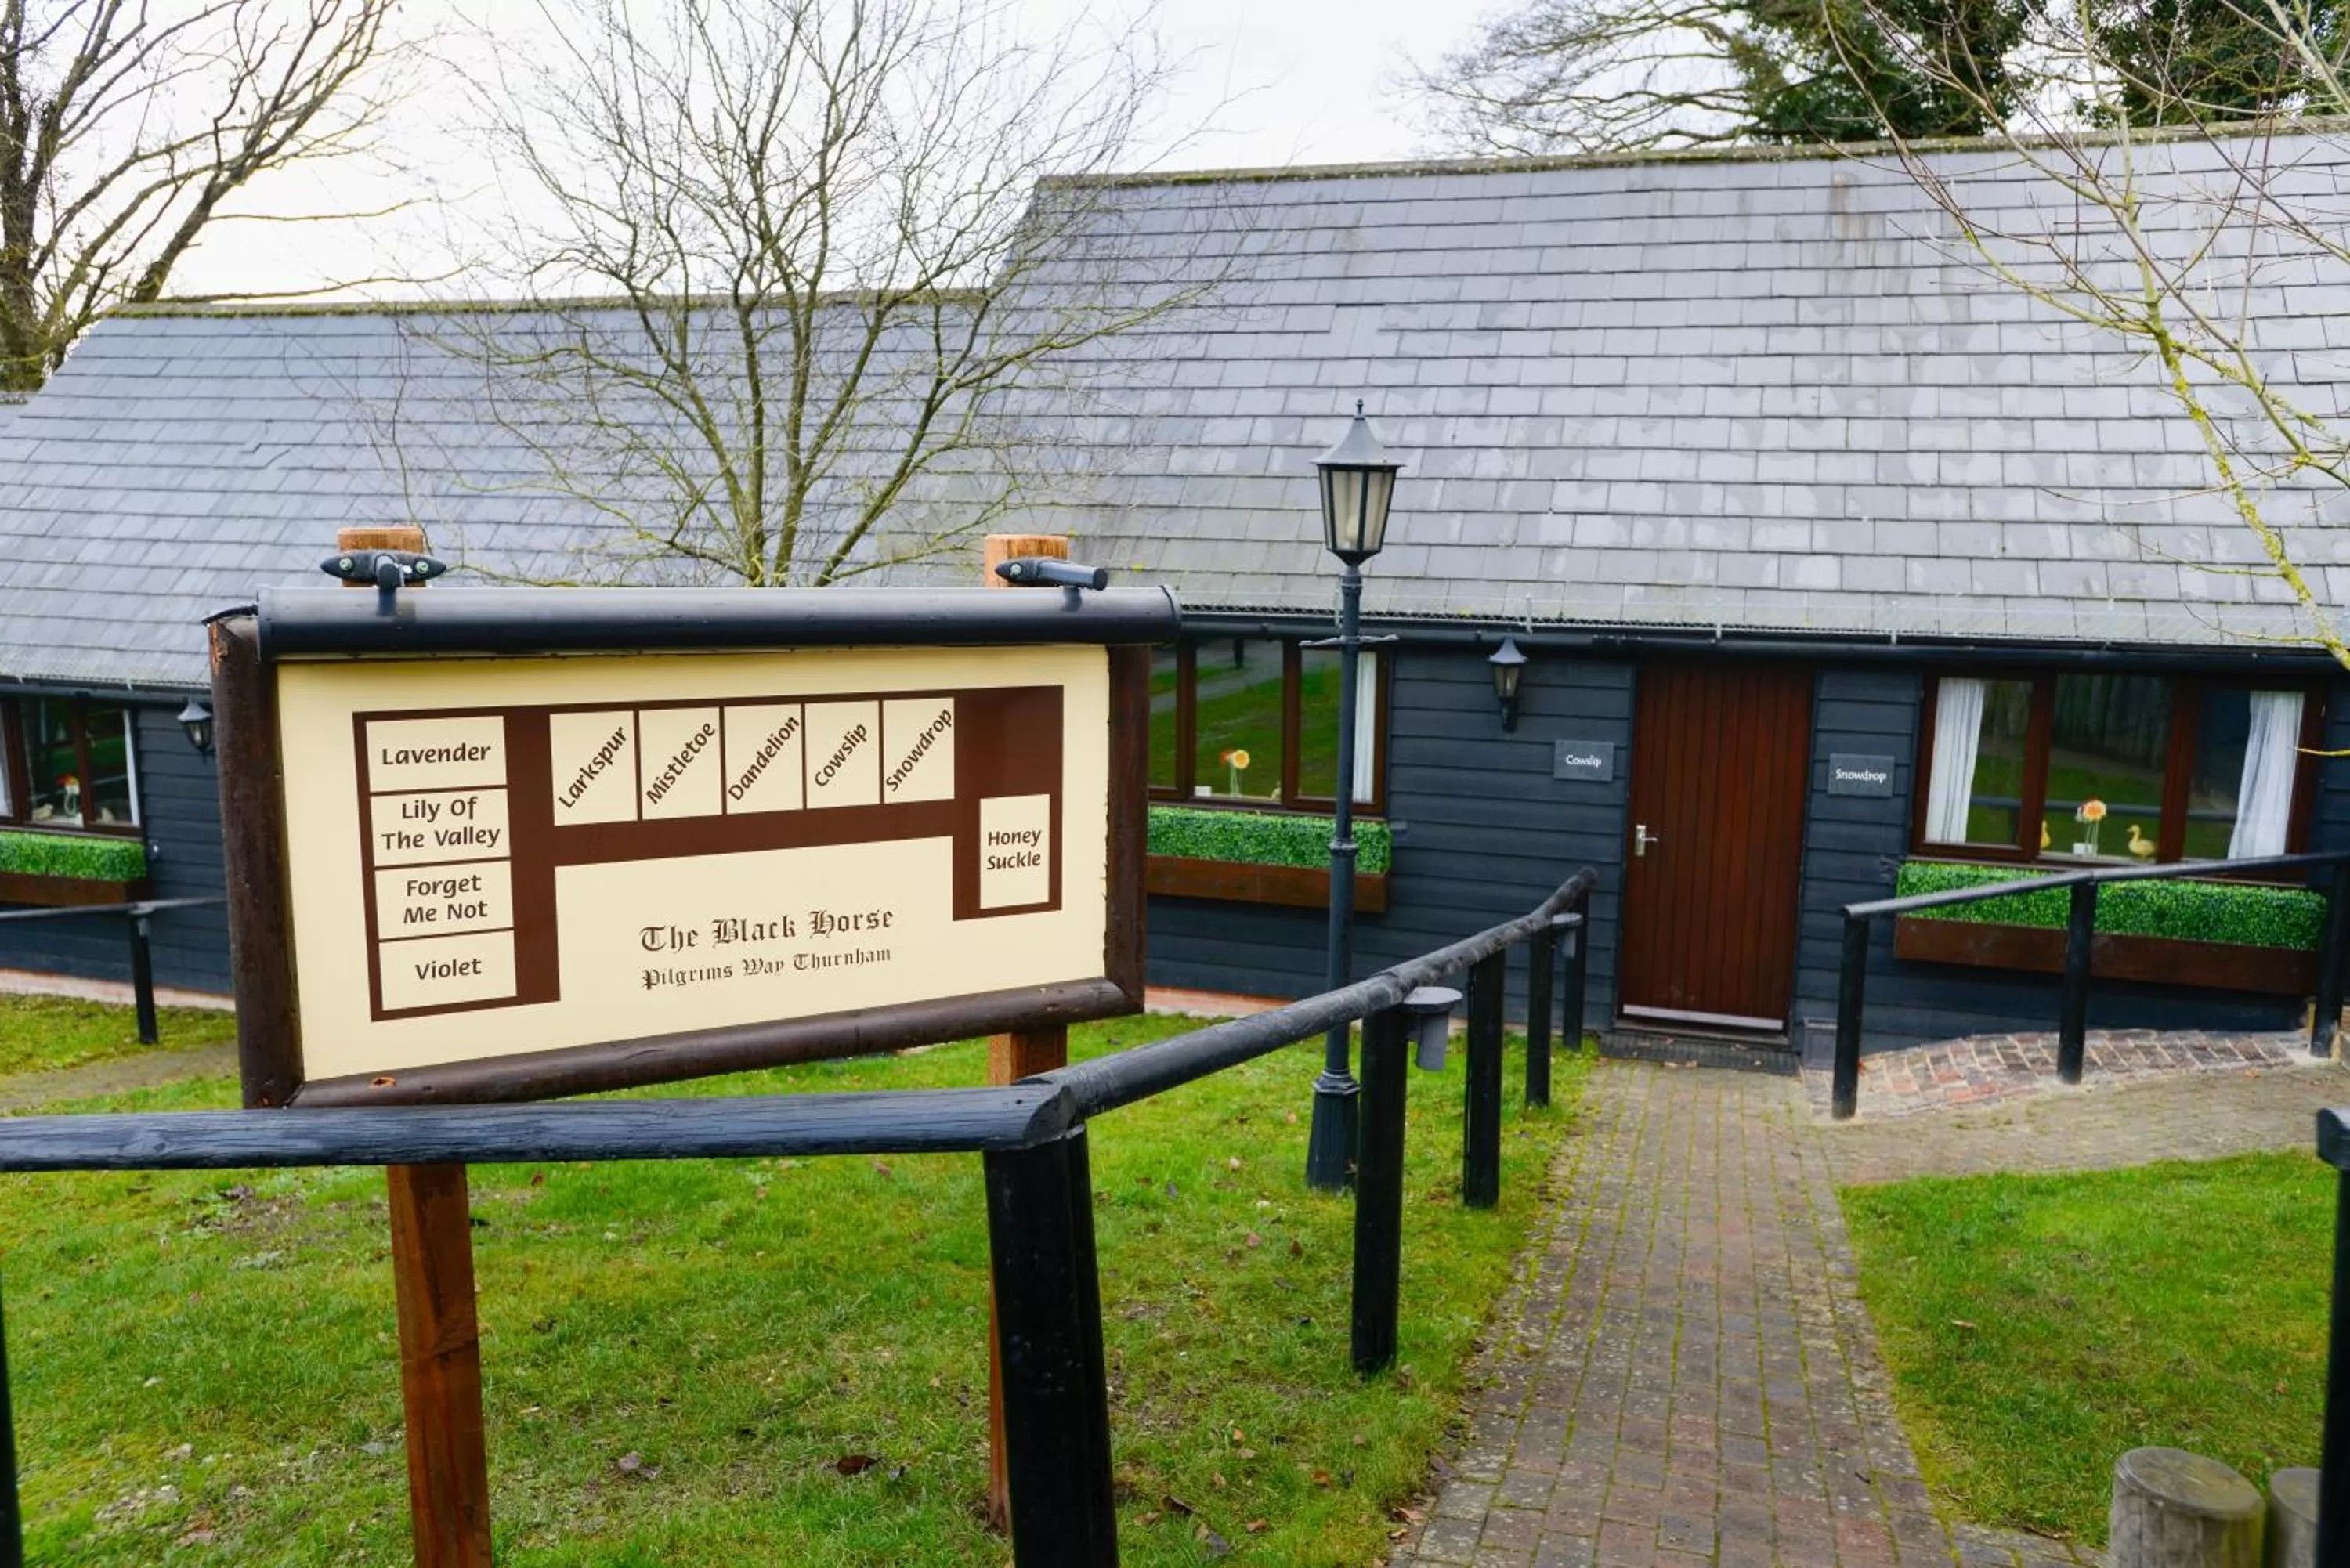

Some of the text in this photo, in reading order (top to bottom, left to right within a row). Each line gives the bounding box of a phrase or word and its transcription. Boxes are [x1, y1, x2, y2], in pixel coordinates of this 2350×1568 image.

[382, 742, 491, 765] Lavender
[646, 723, 715, 804] Mistletoe
[728, 717, 800, 801] Dandelion
[815, 724, 867, 787] Cowslip
[886, 708, 953, 793] Snowdrop
[558, 726, 627, 809] Larkspur
[1835, 768, 1887, 785] Snowdrop
[402, 796, 478, 823] Lily Of
[381, 826, 501, 851] The Valley
[987, 829, 1042, 849] Honey
[986, 851, 1041, 870] Suckle
[407, 874, 482, 898] Forget
[403, 898, 489, 924] Me Not
[640, 909, 894, 953] The Black Horse
[414, 958, 482, 980] Violet
[642, 948, 891, 992] Pilgrims Way Thurnham
